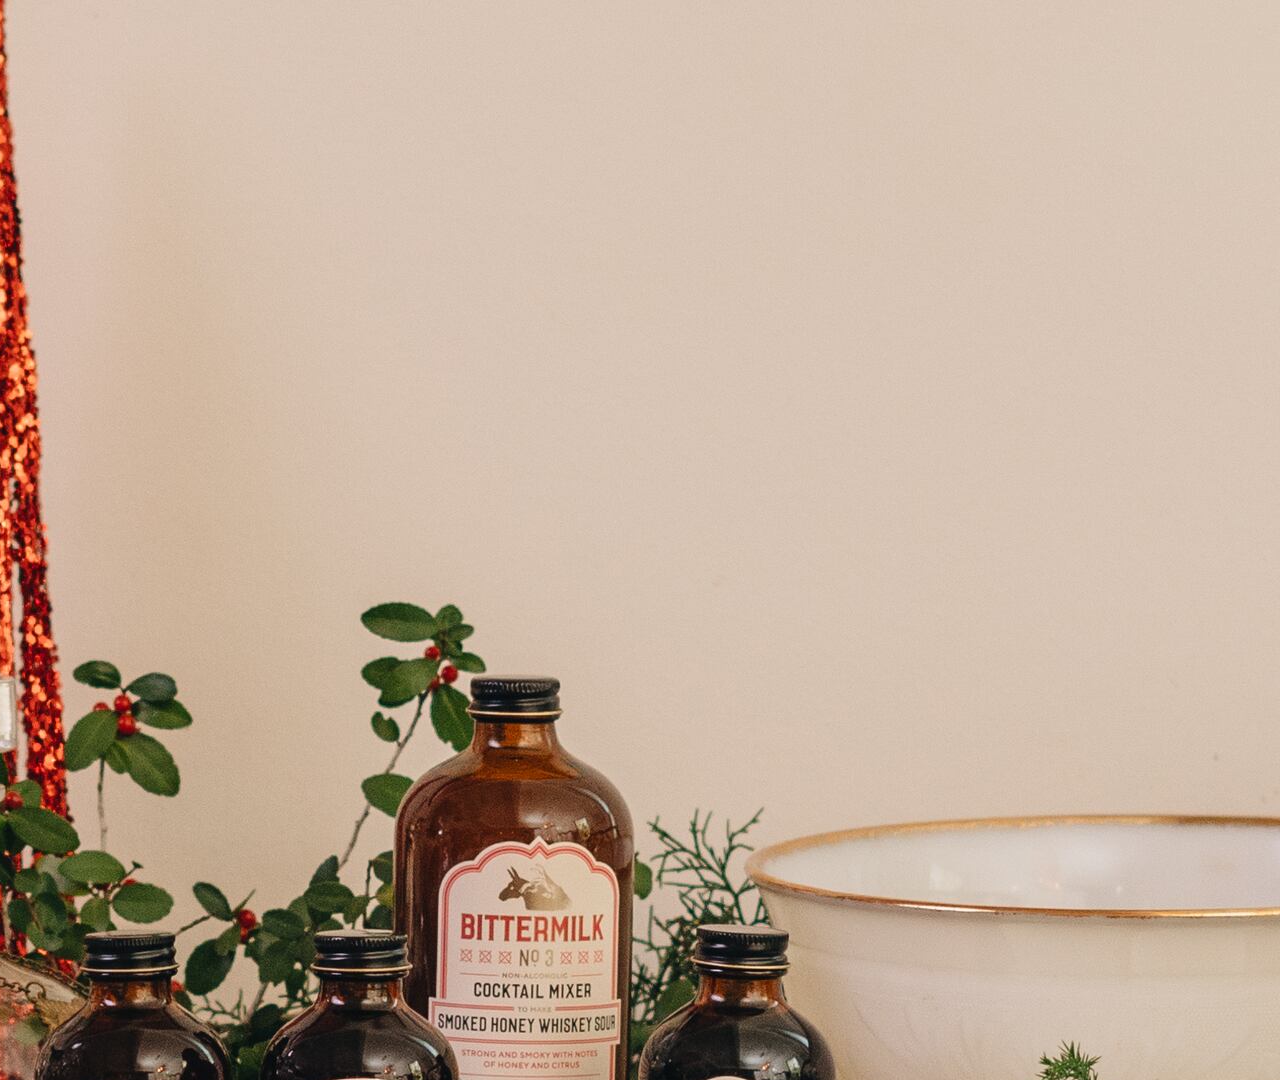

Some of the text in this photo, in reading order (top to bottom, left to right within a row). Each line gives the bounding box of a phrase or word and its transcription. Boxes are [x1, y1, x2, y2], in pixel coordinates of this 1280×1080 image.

[461, 914, 604, 942] BITTERMILK
[545, 951, 554, 966] 3
[474, 982, 591, 999] COCKTAIL MIXER
[438, 1013, 615, 1033] SMOKED HONEY WHISKEY SOUR
[462, 1050, 496, 1058] STRONG
[520, 1051, 550, 1059] SMOKY
